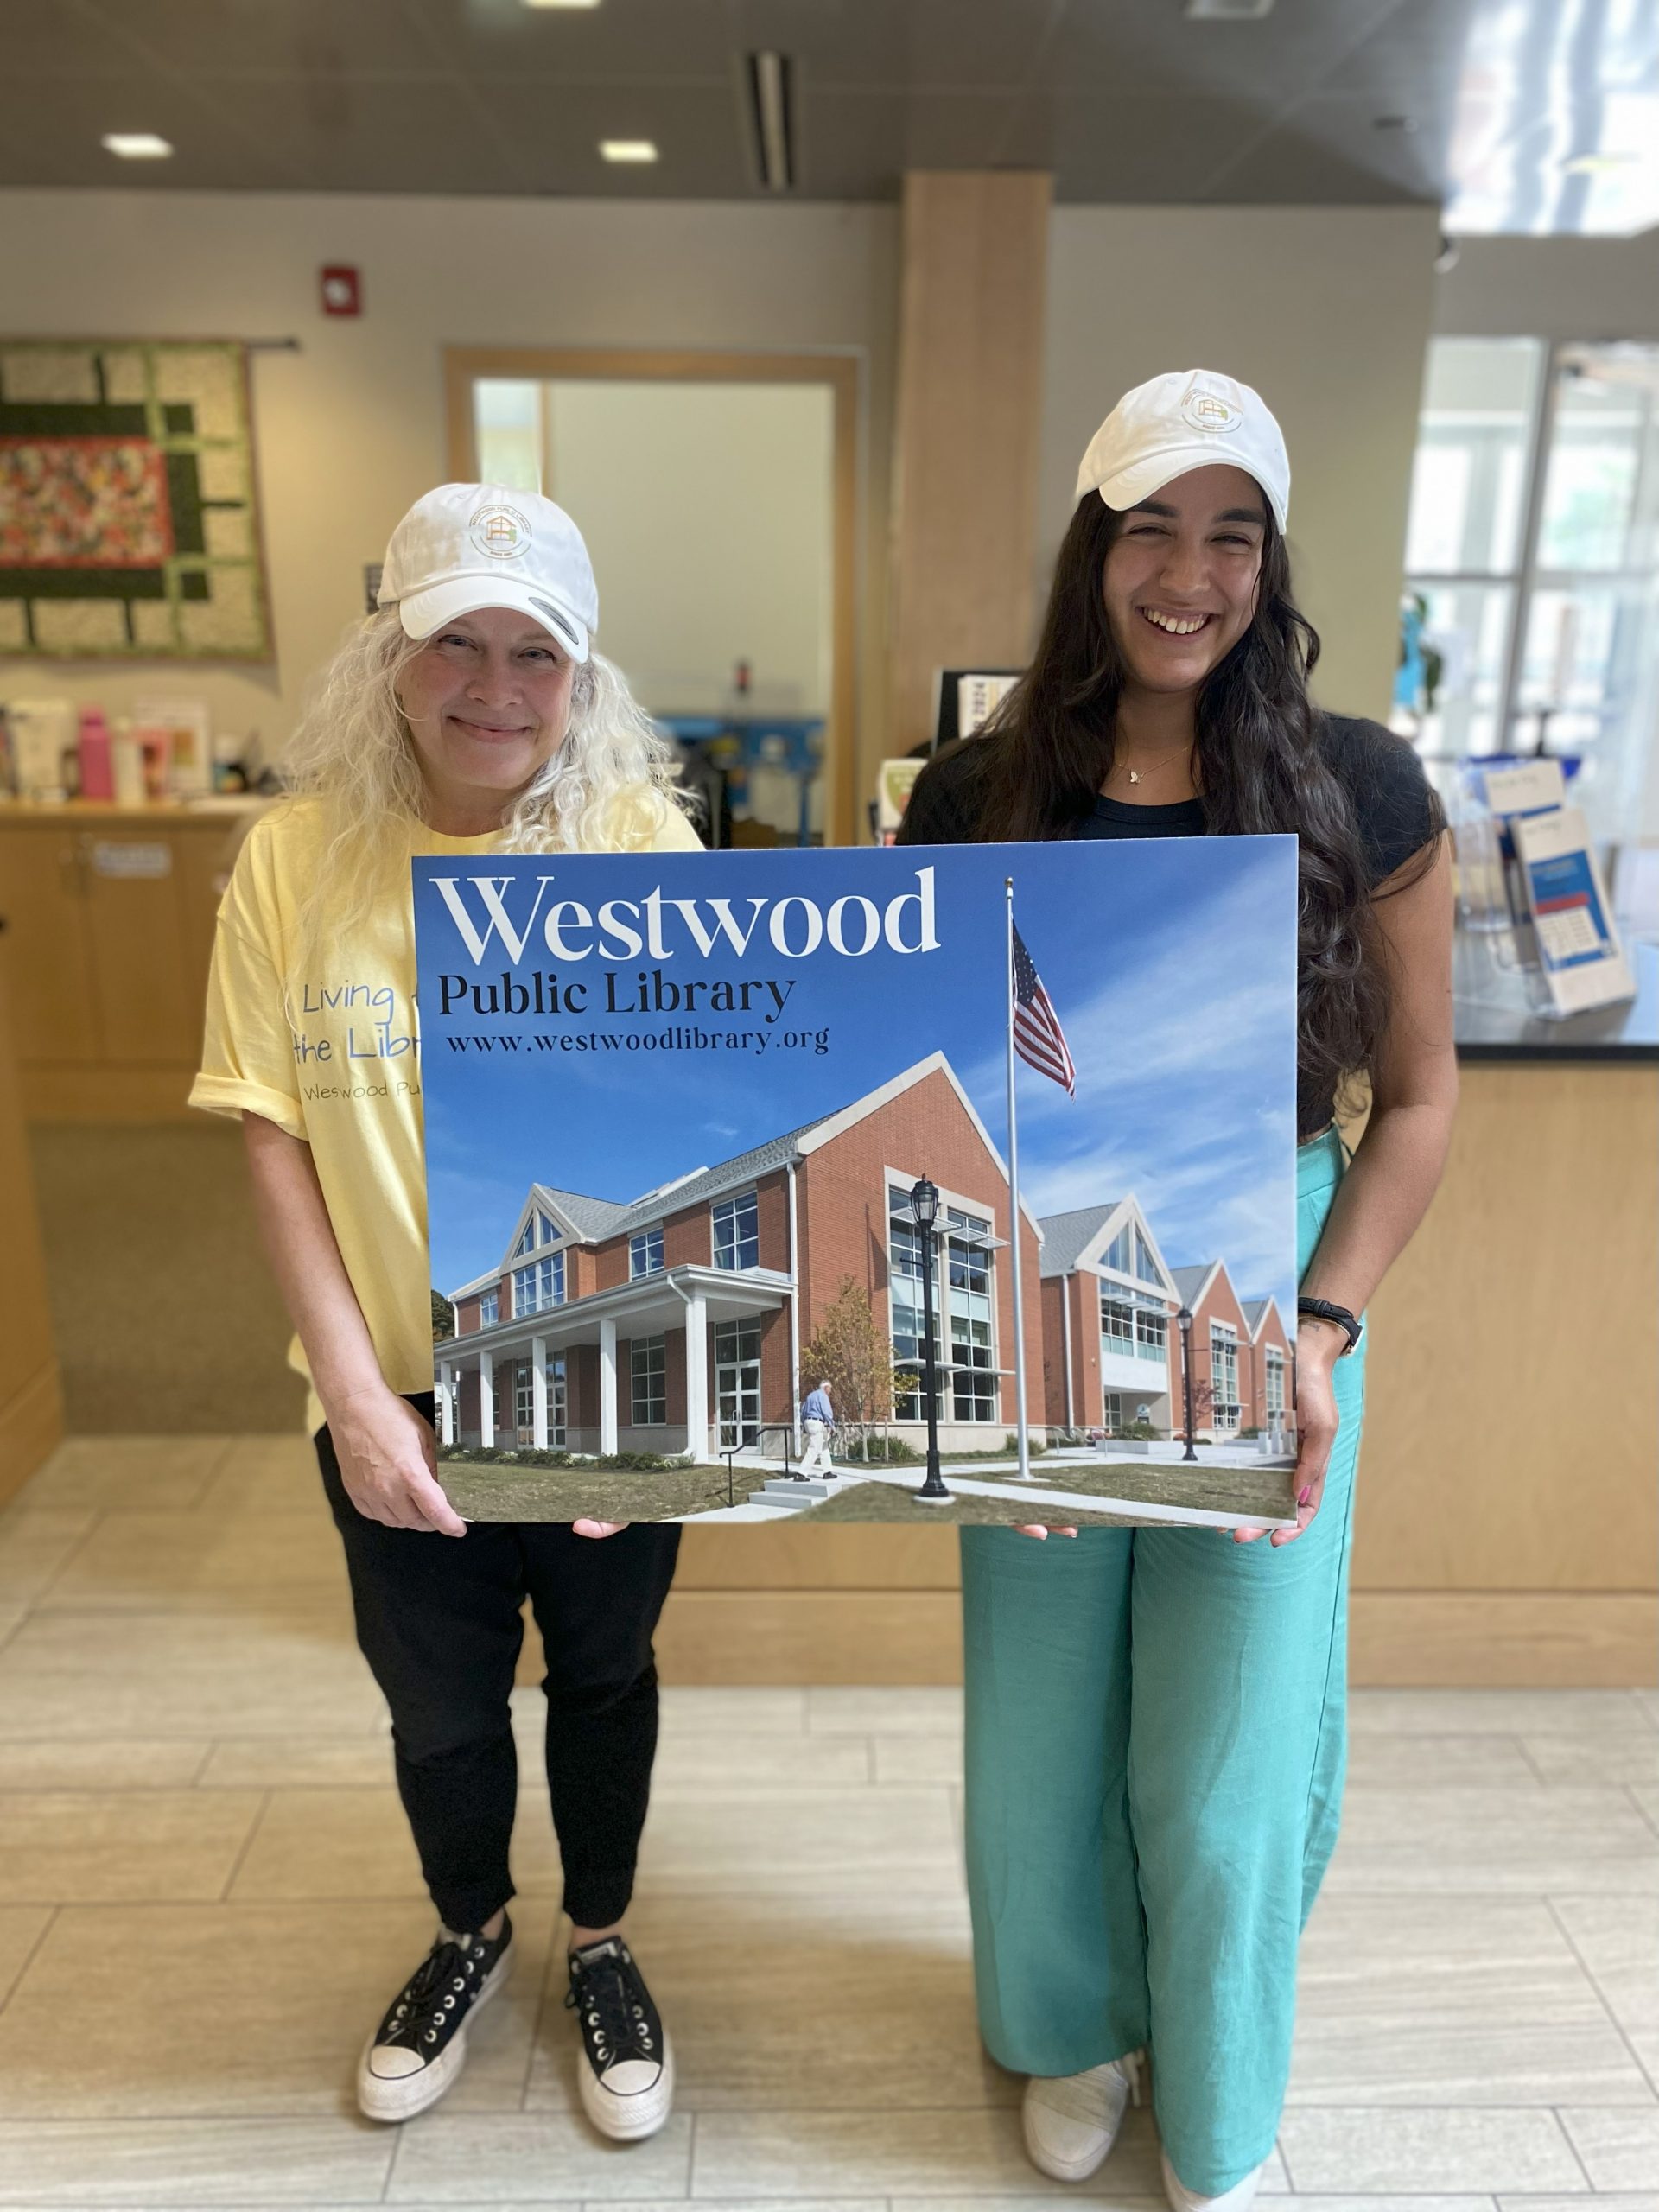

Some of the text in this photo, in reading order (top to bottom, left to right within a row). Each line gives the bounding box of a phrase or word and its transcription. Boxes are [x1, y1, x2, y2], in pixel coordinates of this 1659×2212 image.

[429, 866, 941, 966] Westwood
[303, 980, 394, 1026] Living
[438, 969, 796, 1023] Public Library
[294, 1033, 332, 1065] the
[446, 1027, 830, 1054] www.westwoodlibrary.org
[303, 1079, 421, 1100] Weswood Pu
